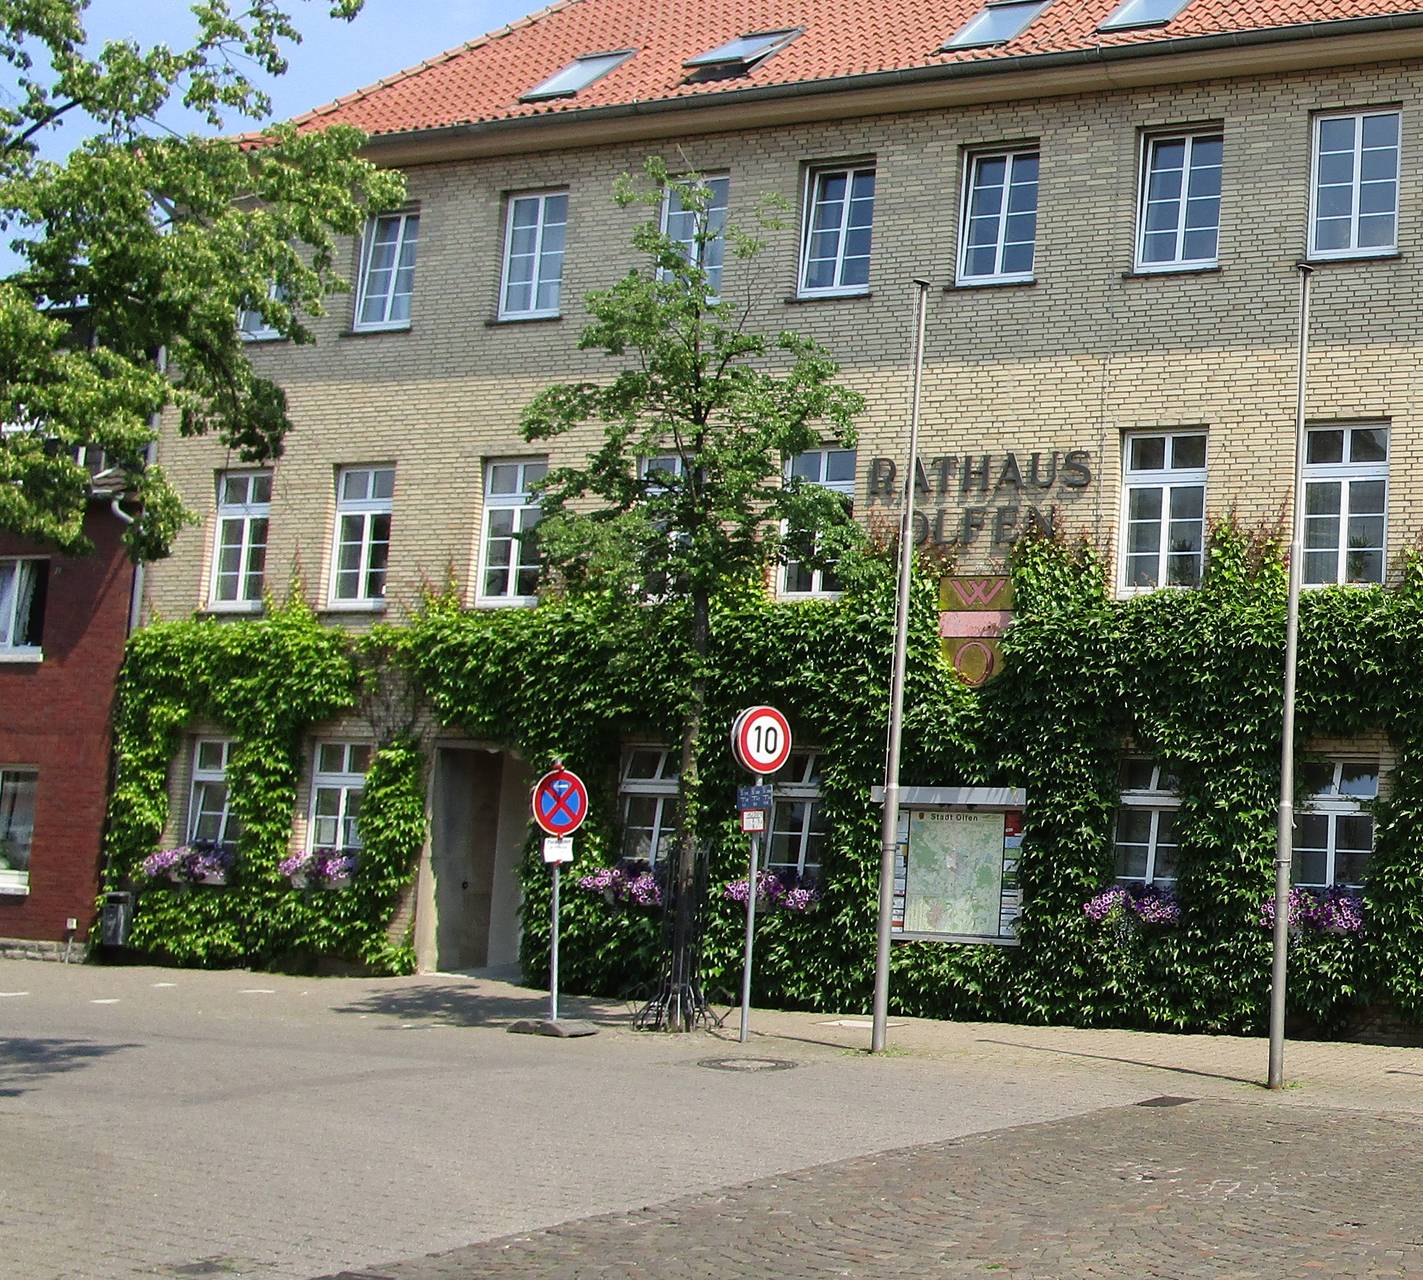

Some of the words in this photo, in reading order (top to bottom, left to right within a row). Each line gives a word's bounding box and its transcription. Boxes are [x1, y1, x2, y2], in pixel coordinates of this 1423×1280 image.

[868, 450, 1092, 497] RATHAUS
[951, 579, 1006, 606] W
[954, 641, 995, 686] O
[754, 725, 778, 754] 10
[930, 813, 953, 821] Stadt
